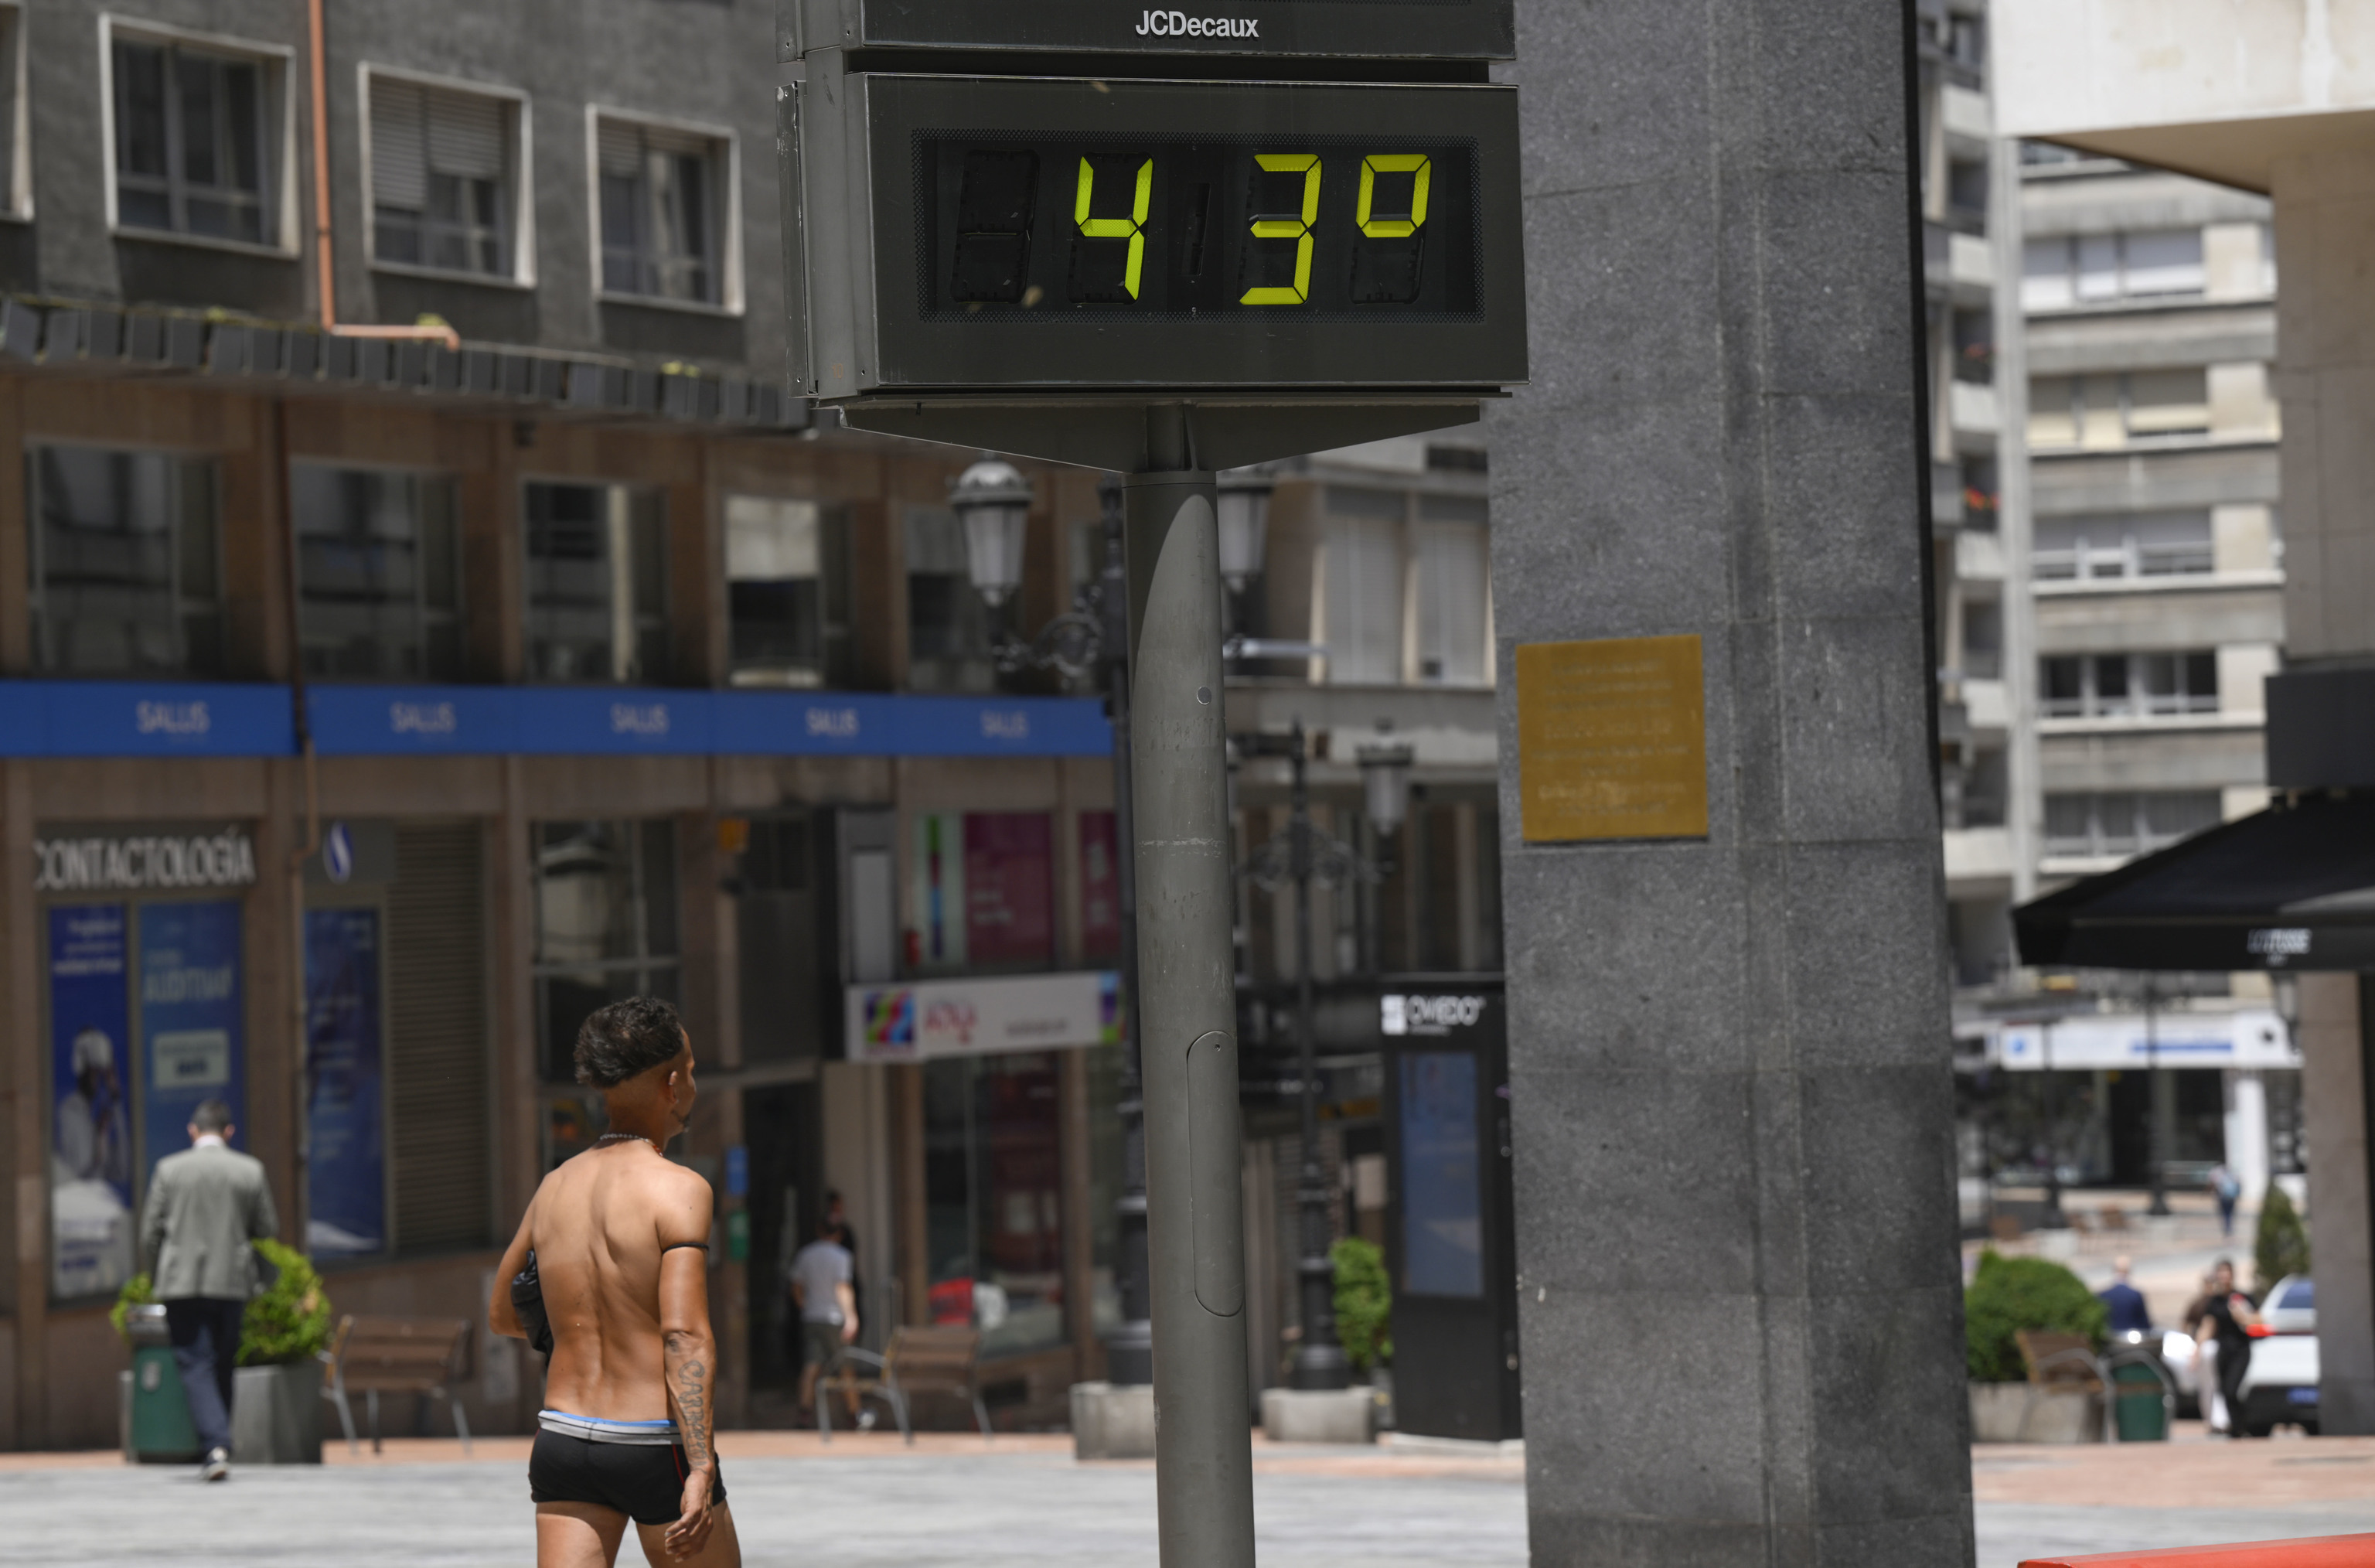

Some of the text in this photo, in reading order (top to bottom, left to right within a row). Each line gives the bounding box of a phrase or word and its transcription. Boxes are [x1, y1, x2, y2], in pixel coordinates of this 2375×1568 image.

[1136, 9, 1259, 38] JCDecaux
[832, 363, 843, 380] 10
[135, 699, 210, 734] SALUS
[389, 700, 457, 734] SALUS
[610, 703, 670, 735] SALUS
